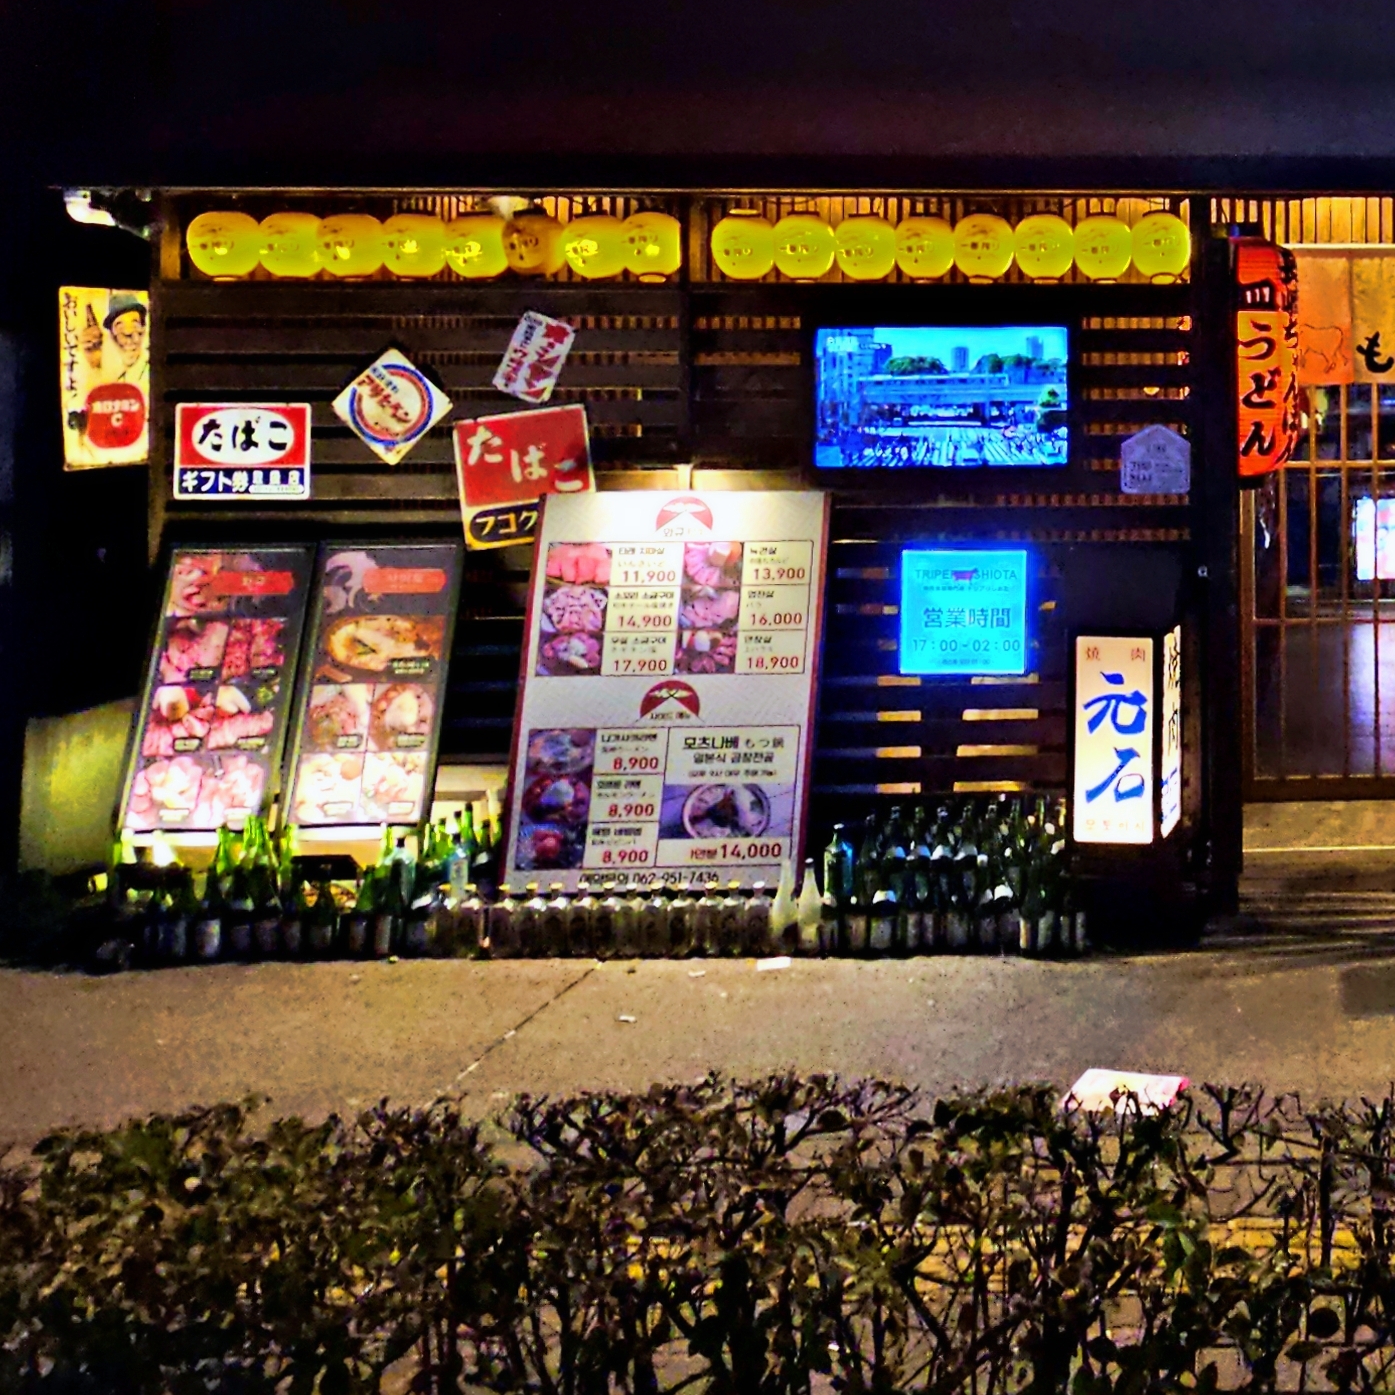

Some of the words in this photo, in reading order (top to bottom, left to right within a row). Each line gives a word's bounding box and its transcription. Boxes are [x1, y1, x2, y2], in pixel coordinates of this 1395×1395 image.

[198, 416, 288, 453] たばこ
[466, 425, 585, 492] たばこ
[623, 570, 676, 584] 11,900
[753, 567, 805, 581] 13,900
[617, 615, 672, 628] 14,900
[750, 613, 803, 627] 16,000
[923, 607, 1012, 629] 営業時間
[613, 659, 667, 673] 17,900
[747, 656, 799, 671] 18,900
[1083, 671, 1148, 803] 元石
[613, 756, 659, 772] 8,900
[608, 803, 655, 818] 8,900
[601, 850, 649, 865] 8,900
[720, 843, 782, 860] 14,000
